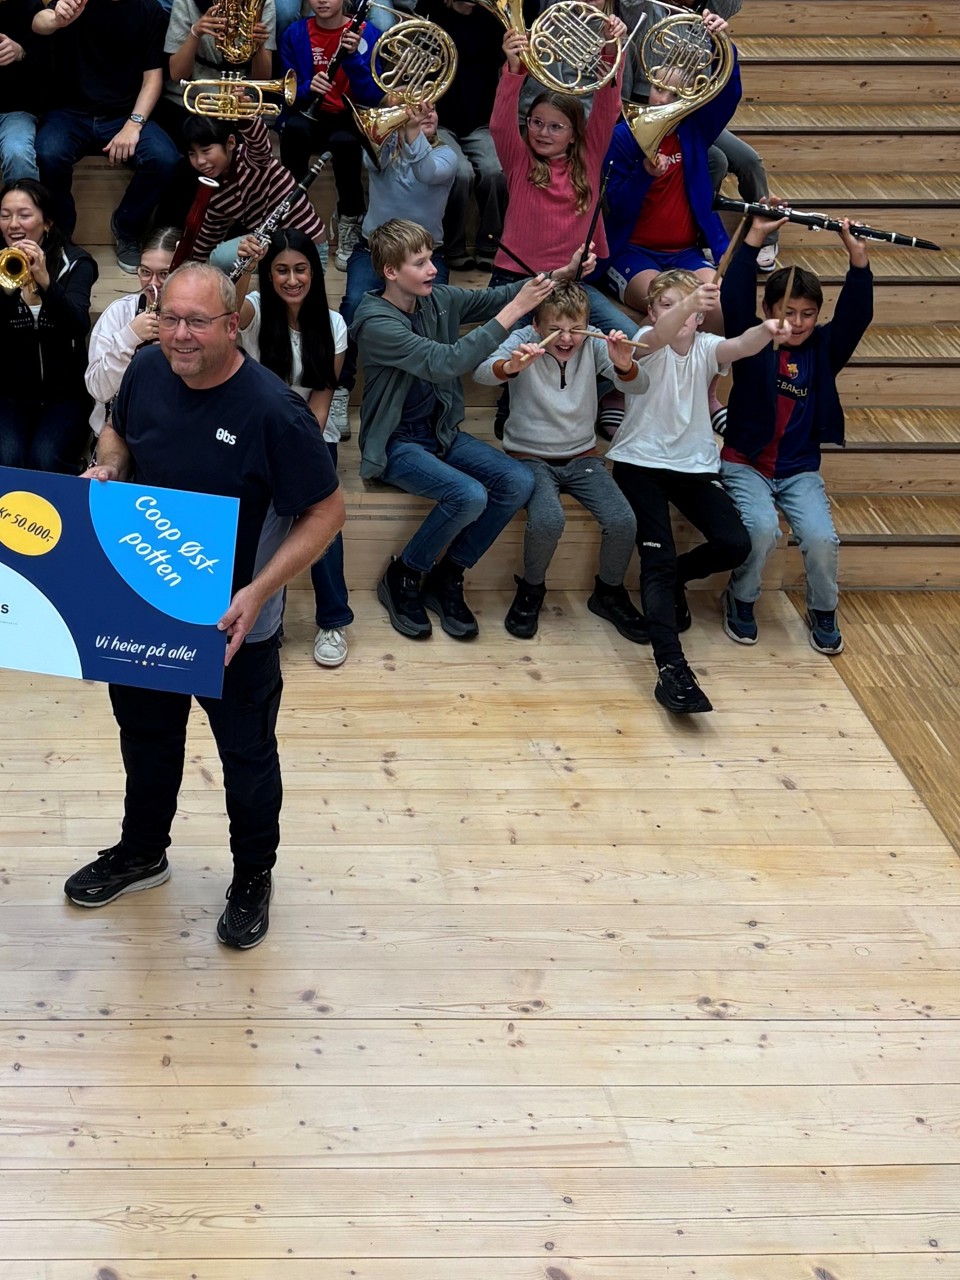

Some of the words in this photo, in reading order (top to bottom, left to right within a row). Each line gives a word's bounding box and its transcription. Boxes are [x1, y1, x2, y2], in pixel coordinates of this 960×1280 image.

[10, 513, 55, 543] 50.000,-
[135, 496, 182, 541] Coop
[177, 541, 220, 575] Øst-
[118, 532, 182, 587] potten
[95, 634, 111, 649] Vi
[110, 635, 146, 654] heier
[145, 642, 167, 659] på
[167, 645, 198, 662] alle!
